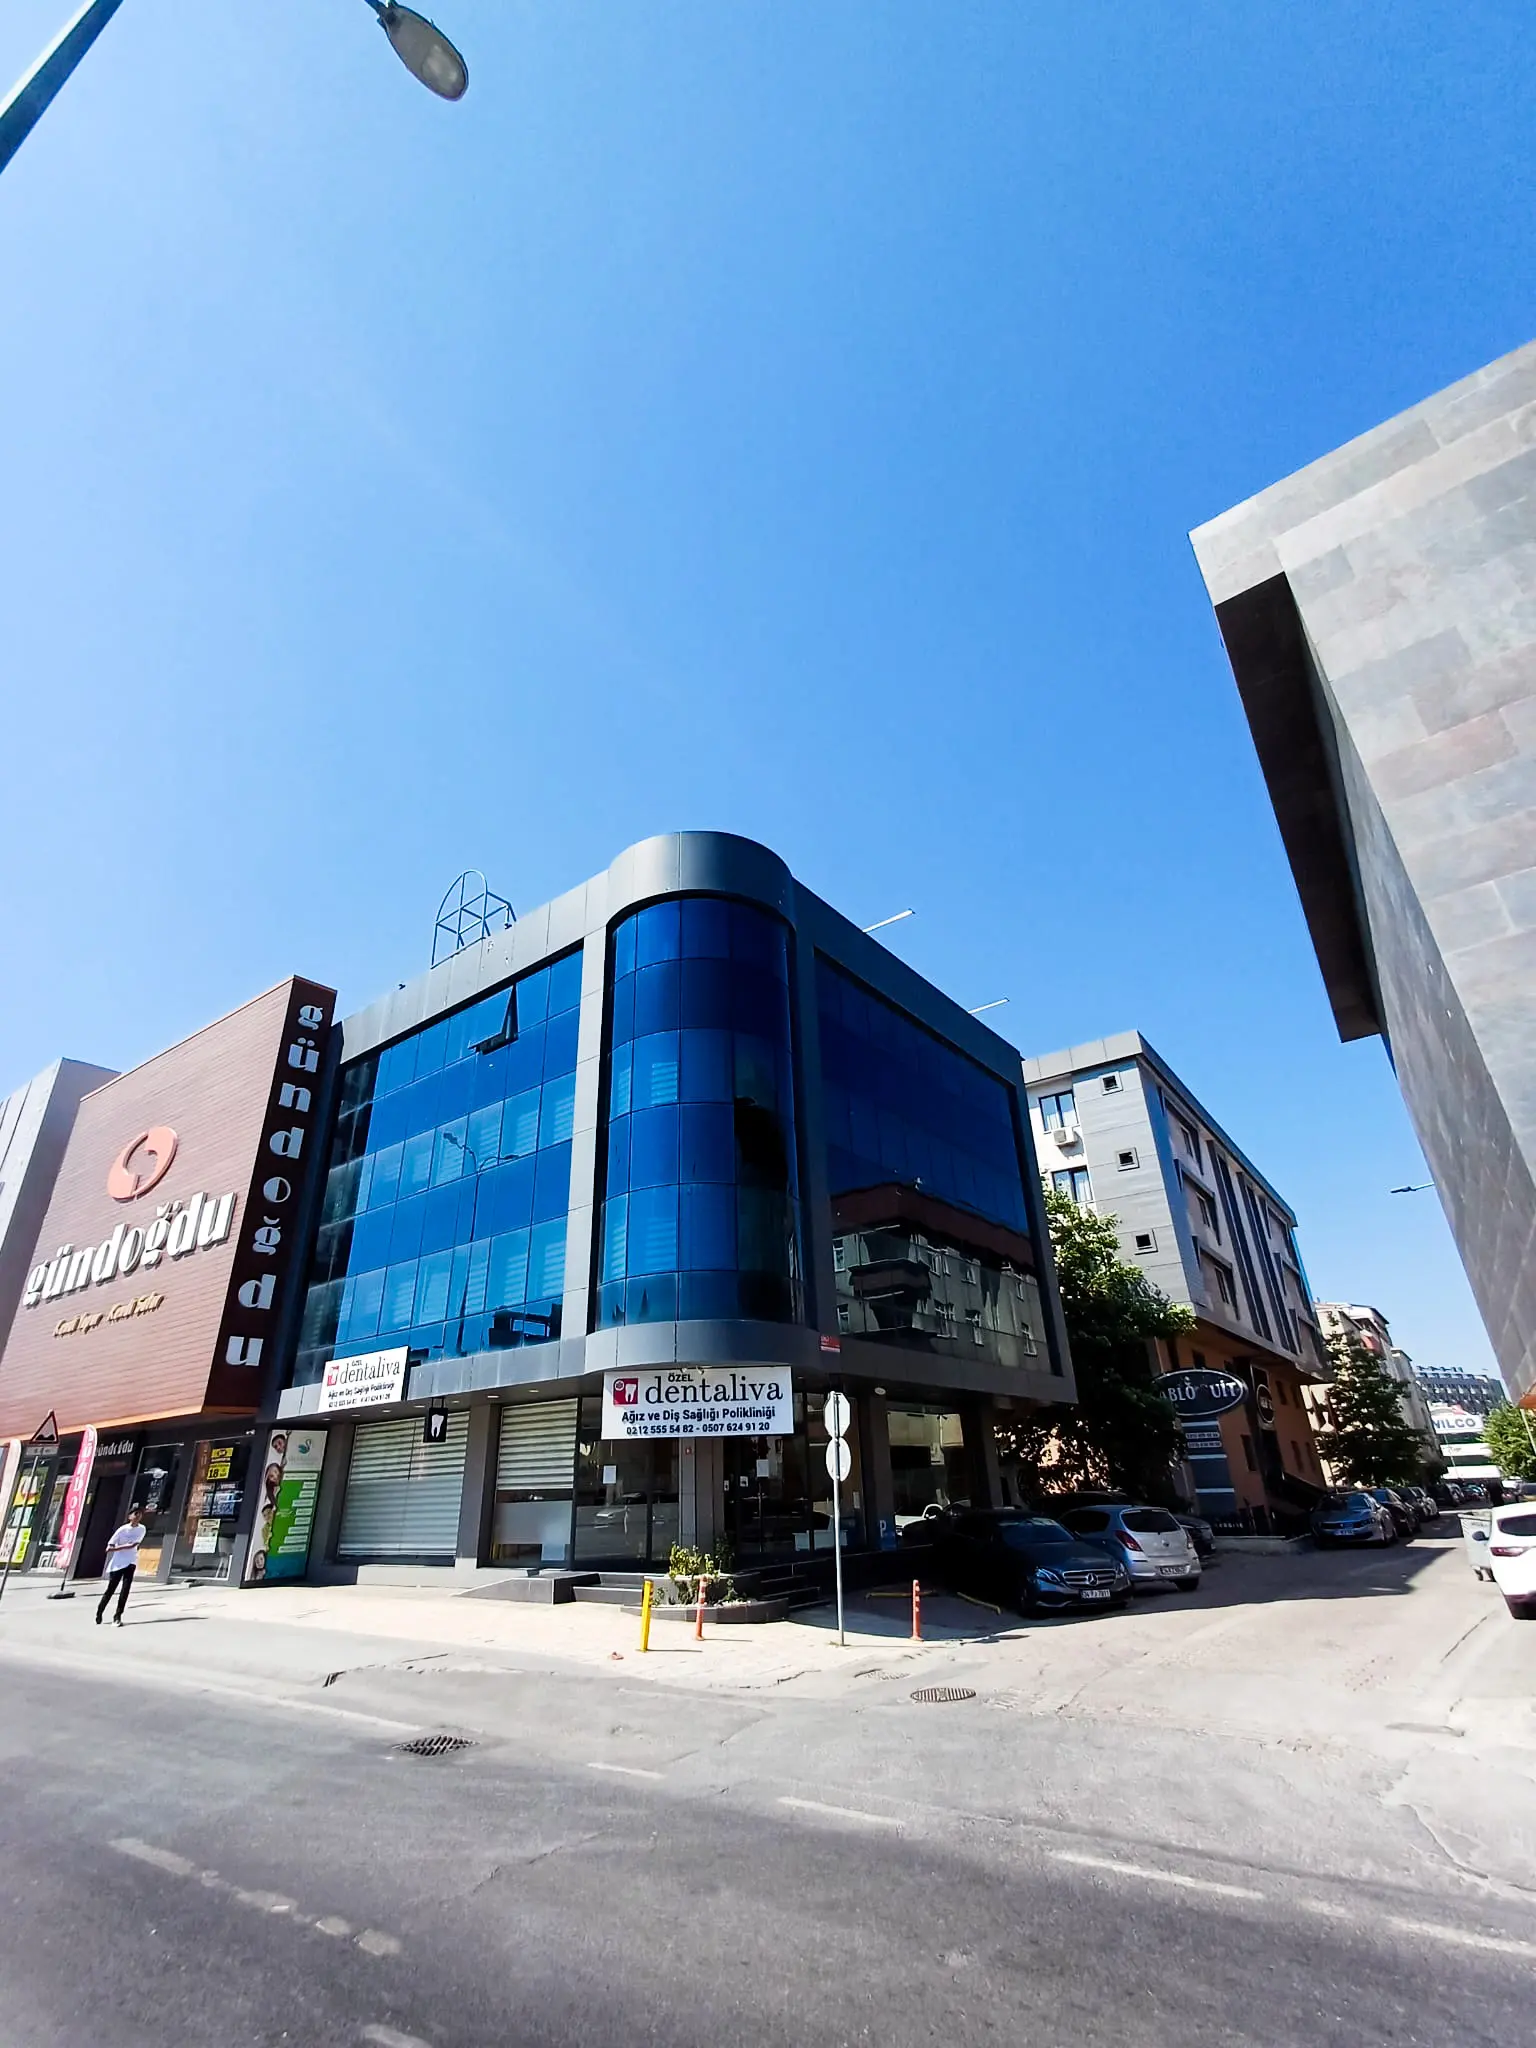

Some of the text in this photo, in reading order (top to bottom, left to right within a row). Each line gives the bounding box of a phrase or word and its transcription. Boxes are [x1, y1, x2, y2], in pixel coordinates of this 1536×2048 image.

[226, 1004, 323, 1366] gündoğdu
[24, 1191, 236, 1306] gündoğdu
[340, 1356, 400, 1384] dentaliva
[668, 1373, 694, 1382] ÖZEL
[645, 1374, 783, 1404] dentaliva
[622, 1406, 776, 1424] Ağız ve Diş Sağlığı Polikliniği
[626, 1425, 649, 1435] 0212
[650, 1424, 667, 1434] 555
[669, 1424, 680, 1433] 54
[683, 1424, 694, 1433] 82
[702, 1423, 724, 1433] 0507
[727, 1422, 743, 1432] 624
[745, 1422, 756, 1431] 91
[759, 1421, 770, 1431] 20
